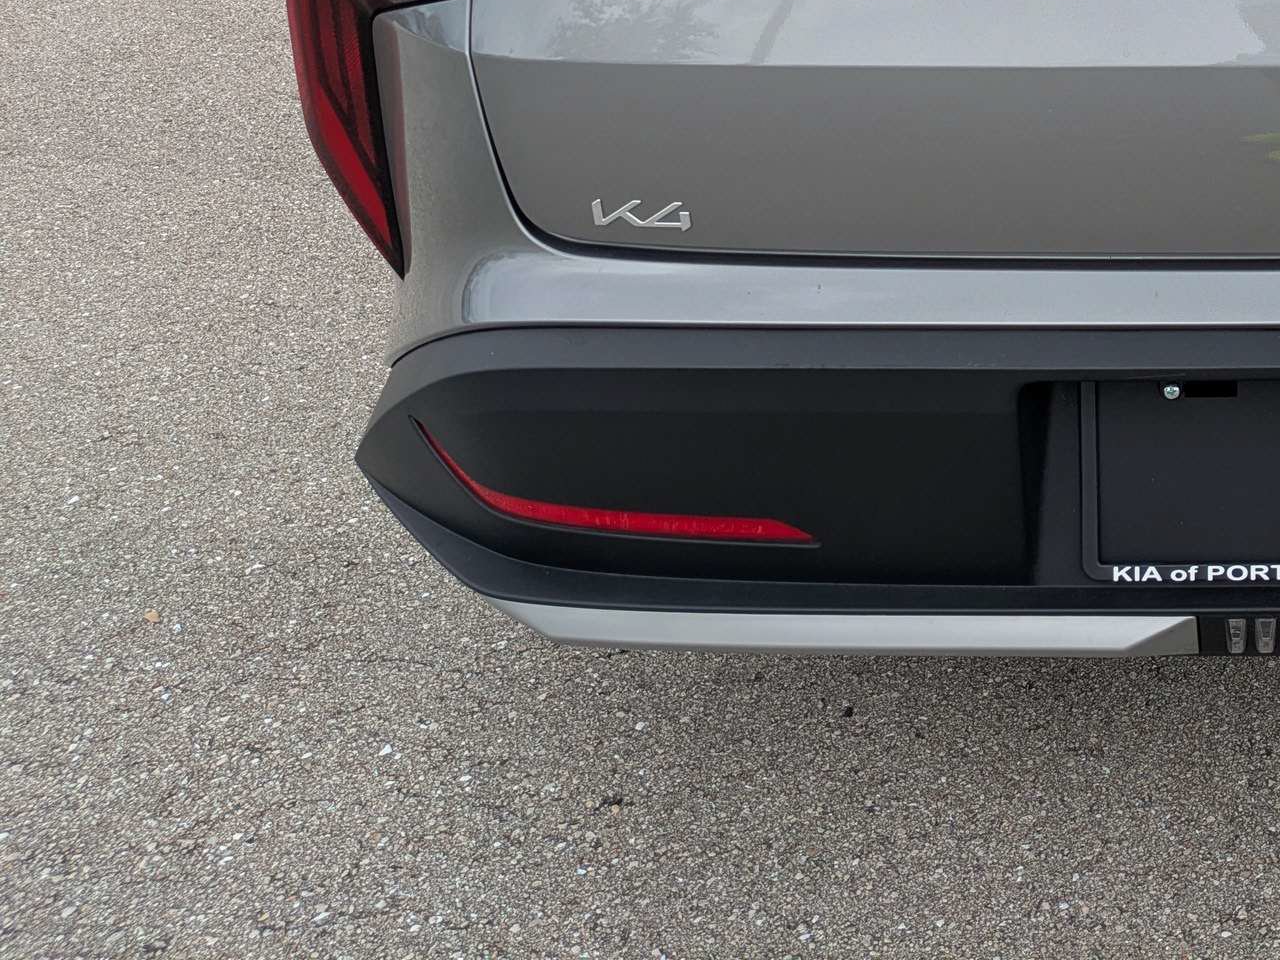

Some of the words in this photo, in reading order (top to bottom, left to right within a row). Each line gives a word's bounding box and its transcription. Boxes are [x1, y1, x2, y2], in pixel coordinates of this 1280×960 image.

[591, 198, 692, 232] K4
[1112, 565, 1163, 582] KIA
[1169, 565, 1199, 582] of
